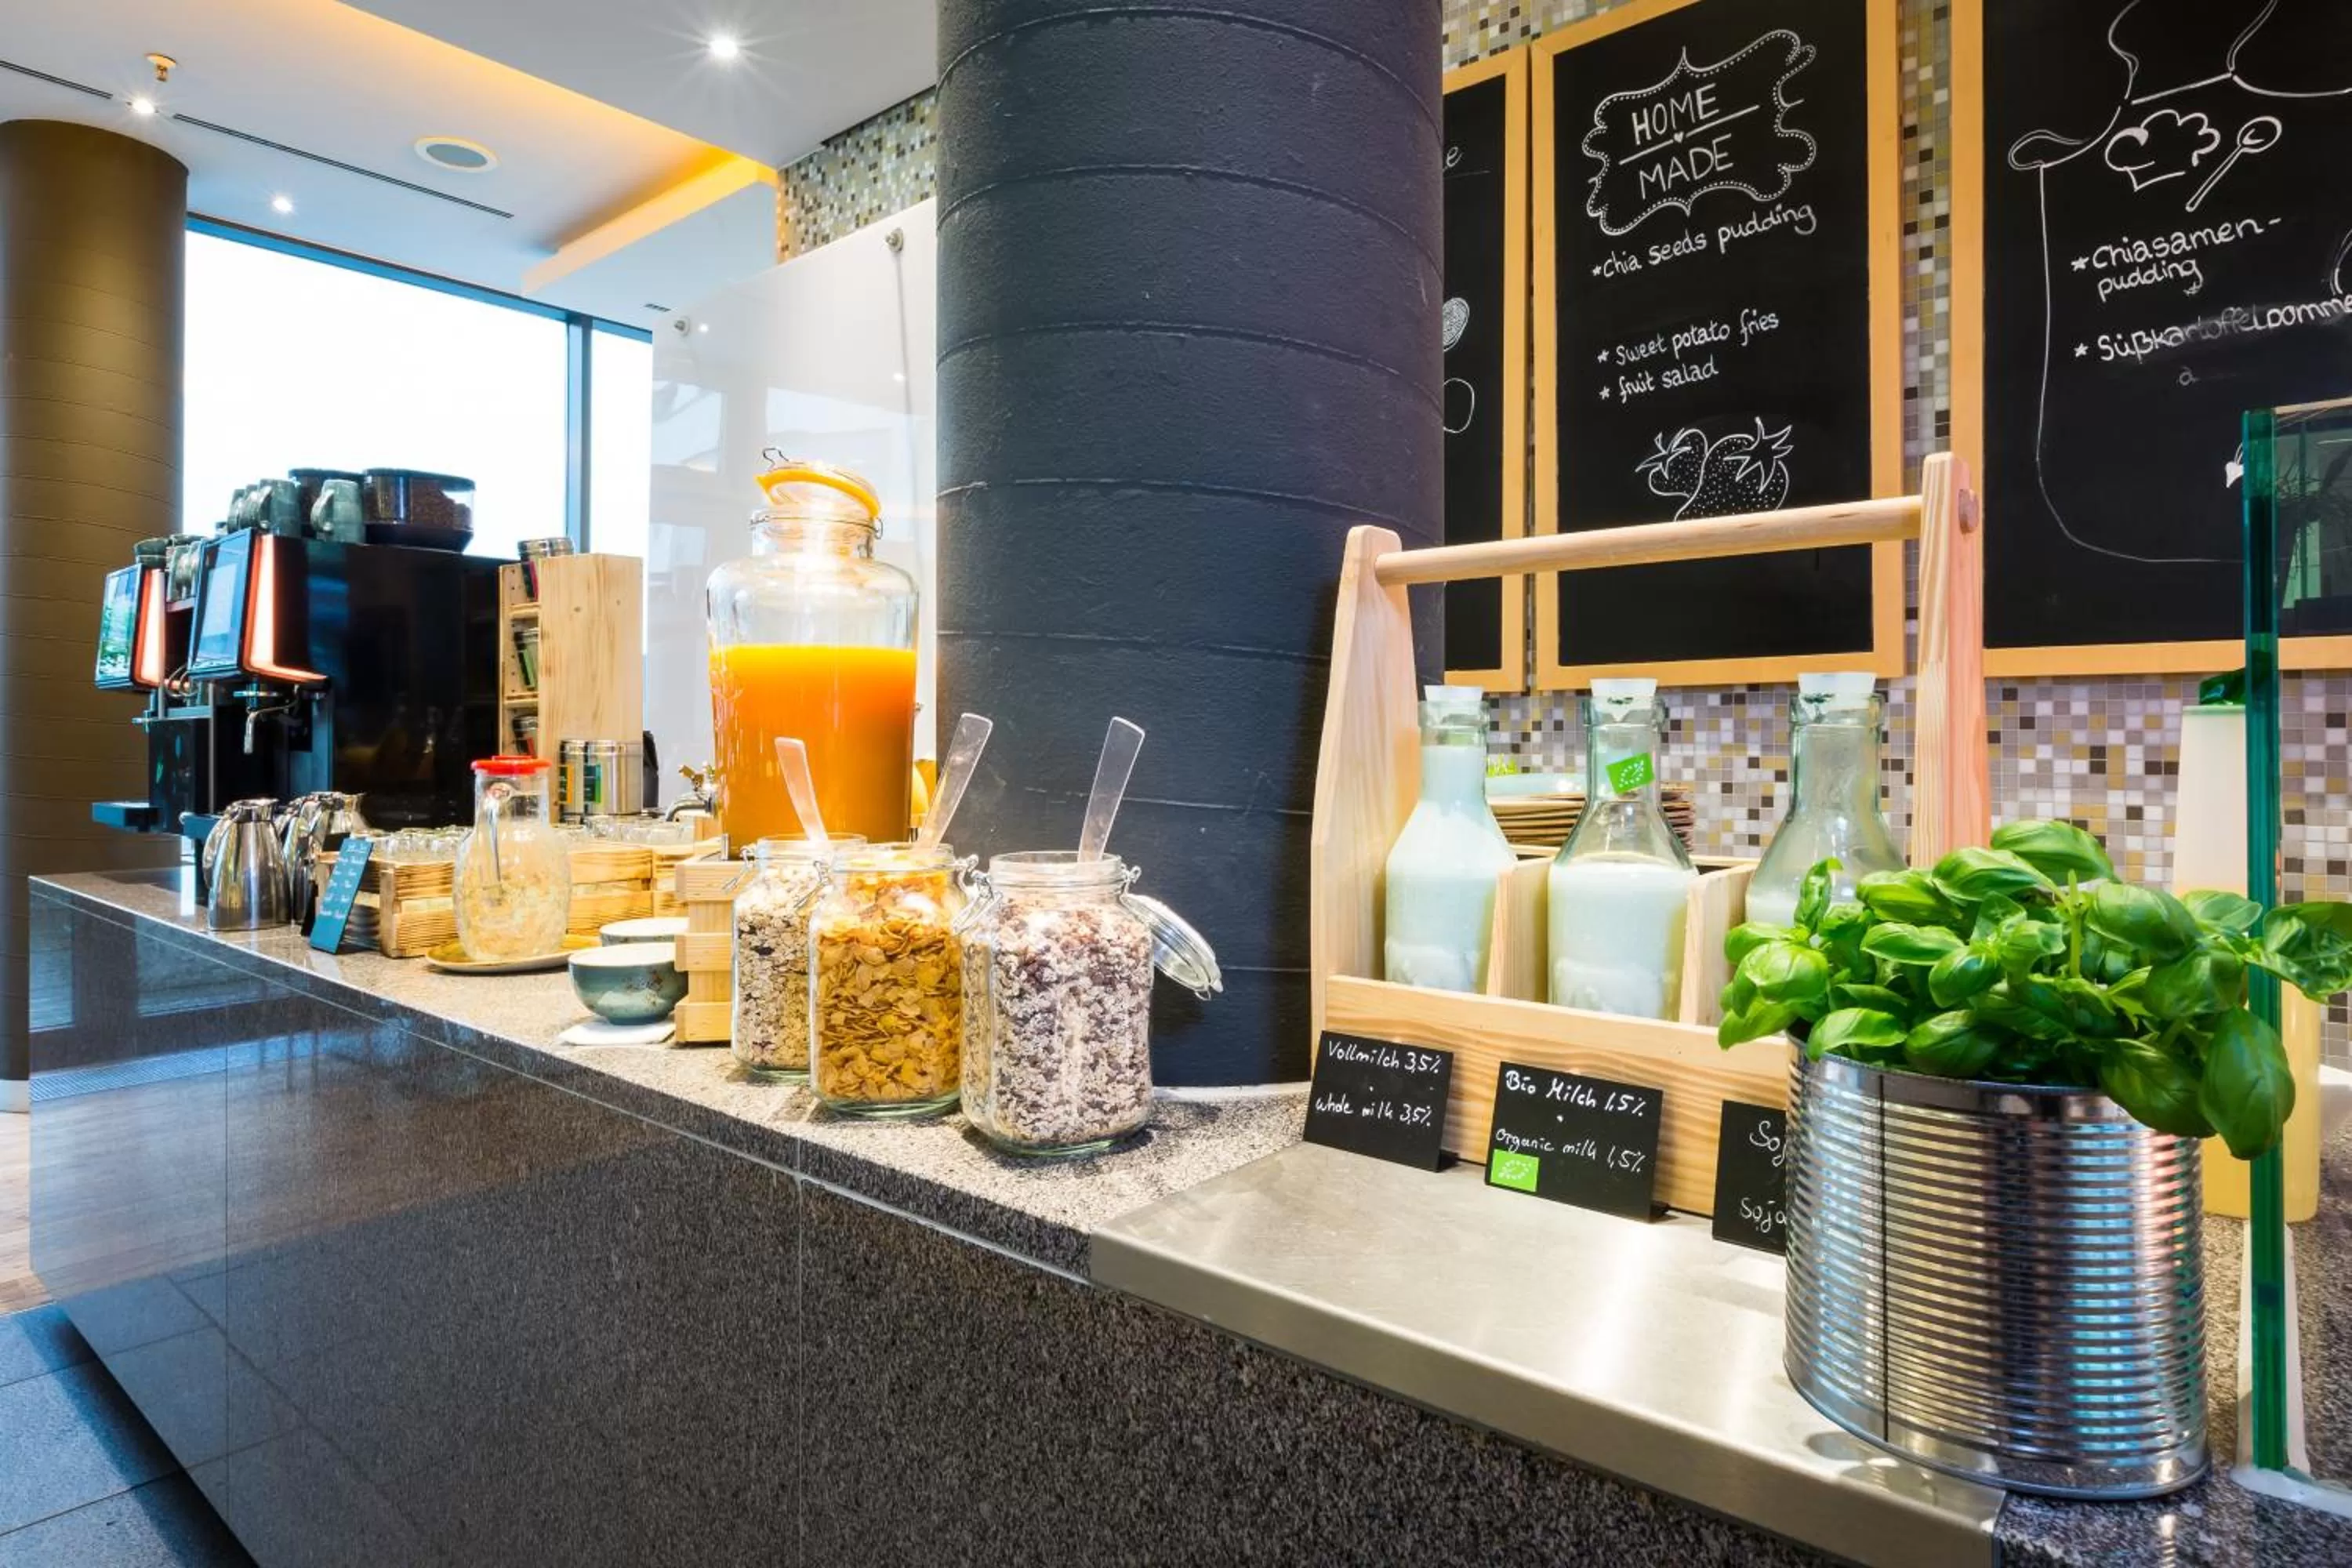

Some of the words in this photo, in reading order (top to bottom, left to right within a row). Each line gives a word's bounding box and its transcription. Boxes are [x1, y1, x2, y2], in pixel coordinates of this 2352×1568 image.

[1632, 82, 1720, 146] HOME
[1639, 133, 1734, 201] MADE
[1648, 230, 1708, 266] seeds
[1718, 204, 1817, 255] pudding
[2098, 258, 2205, 303] pudding
[1672, 321, 1731, 358] potato
[1738, 308, 1780, 347] fries
[1619, 371, 1657, 404] fruit
[1662, 354, 1719, 389] salad
[1329, 1040, 1400, 1069] Vollmilch
[1362, 1100, 1393, 1120] milk
[1504, 1069, 1537, 1095] Bio
[1545, 1077, 1597, 1108] Milch
[1603, 1091, 1647, 1117] 1,5%
[1563, 1138, 1598, 1161] milk
[1607, 1145, 1646, 1173] 1,5%
